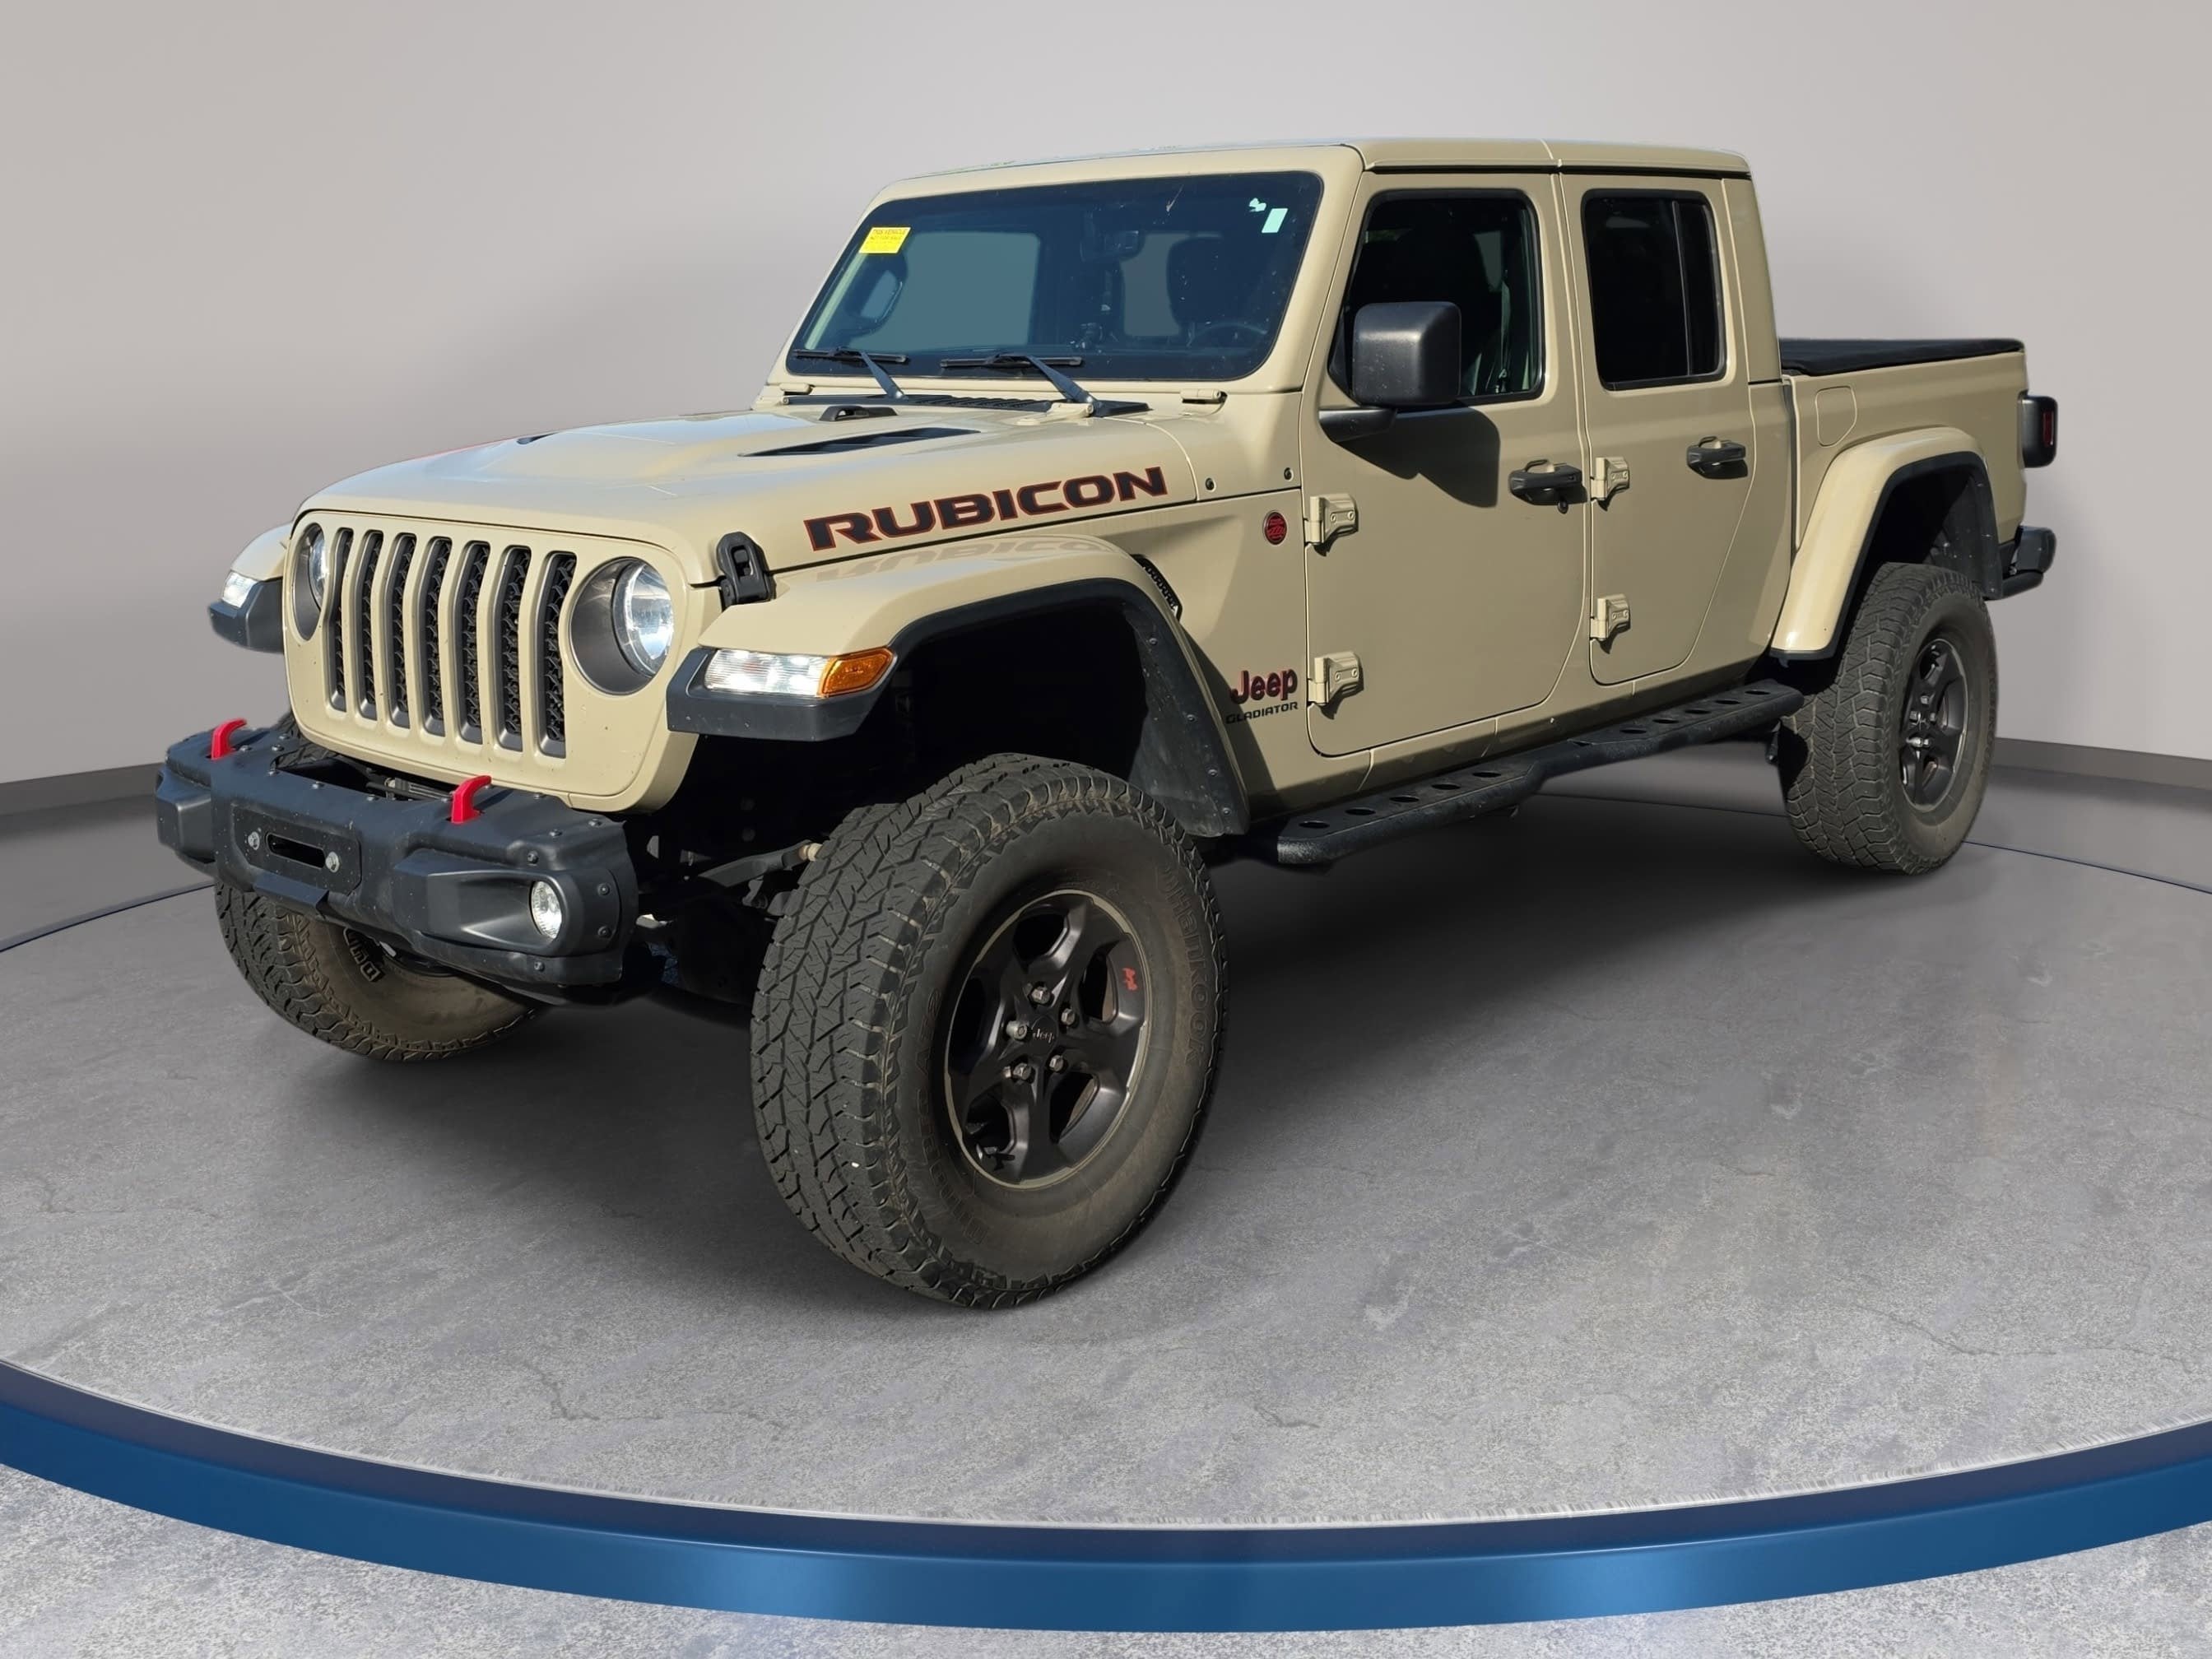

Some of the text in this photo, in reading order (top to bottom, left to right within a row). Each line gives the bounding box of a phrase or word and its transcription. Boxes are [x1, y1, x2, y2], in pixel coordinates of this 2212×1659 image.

[803, 466, 1169, 552] RUBICON
[1229, 668, 1298, 704] Jeep
[1225, 701, 1299, 724] GLADIATOR
